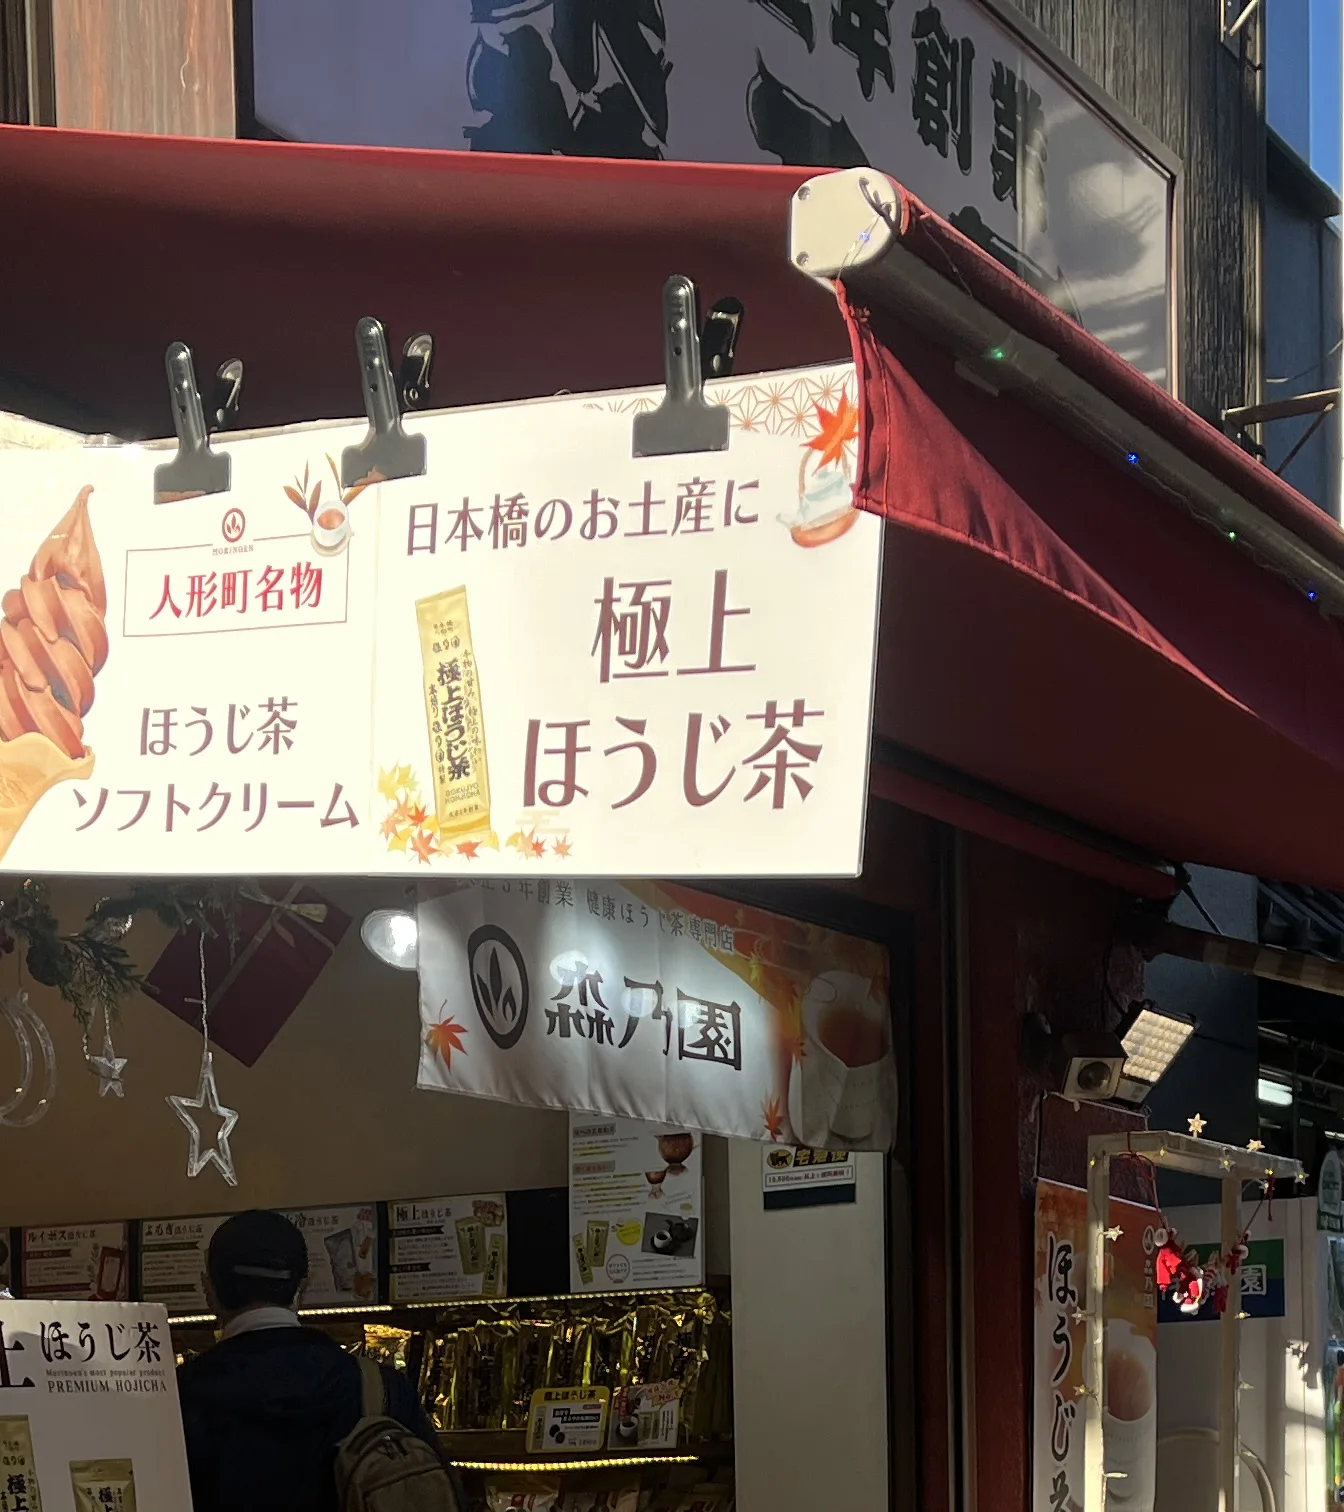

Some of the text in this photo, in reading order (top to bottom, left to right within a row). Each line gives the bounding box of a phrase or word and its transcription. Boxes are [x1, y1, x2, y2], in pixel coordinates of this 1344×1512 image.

[404, 476, 761, 556] 日本橋のお土産に
[149, 561, 324, 620] 人形町名物
[590, 566, 757, 684] 極上
[140, 696, 299, 757] ほうじ茶
[436, 656, 472, 782] 極上ほうじ茶
[523, 698, 826, 811] ほうじ茶
[71, 781, 361, 833] ソフトクリーム
[586, 887, 735, 952] 健康ほうじ茶専門店
[545, 961, 743, 1071] 森乃園
[48, 1377, 167, 1394] PREMIUM HOJICHA
